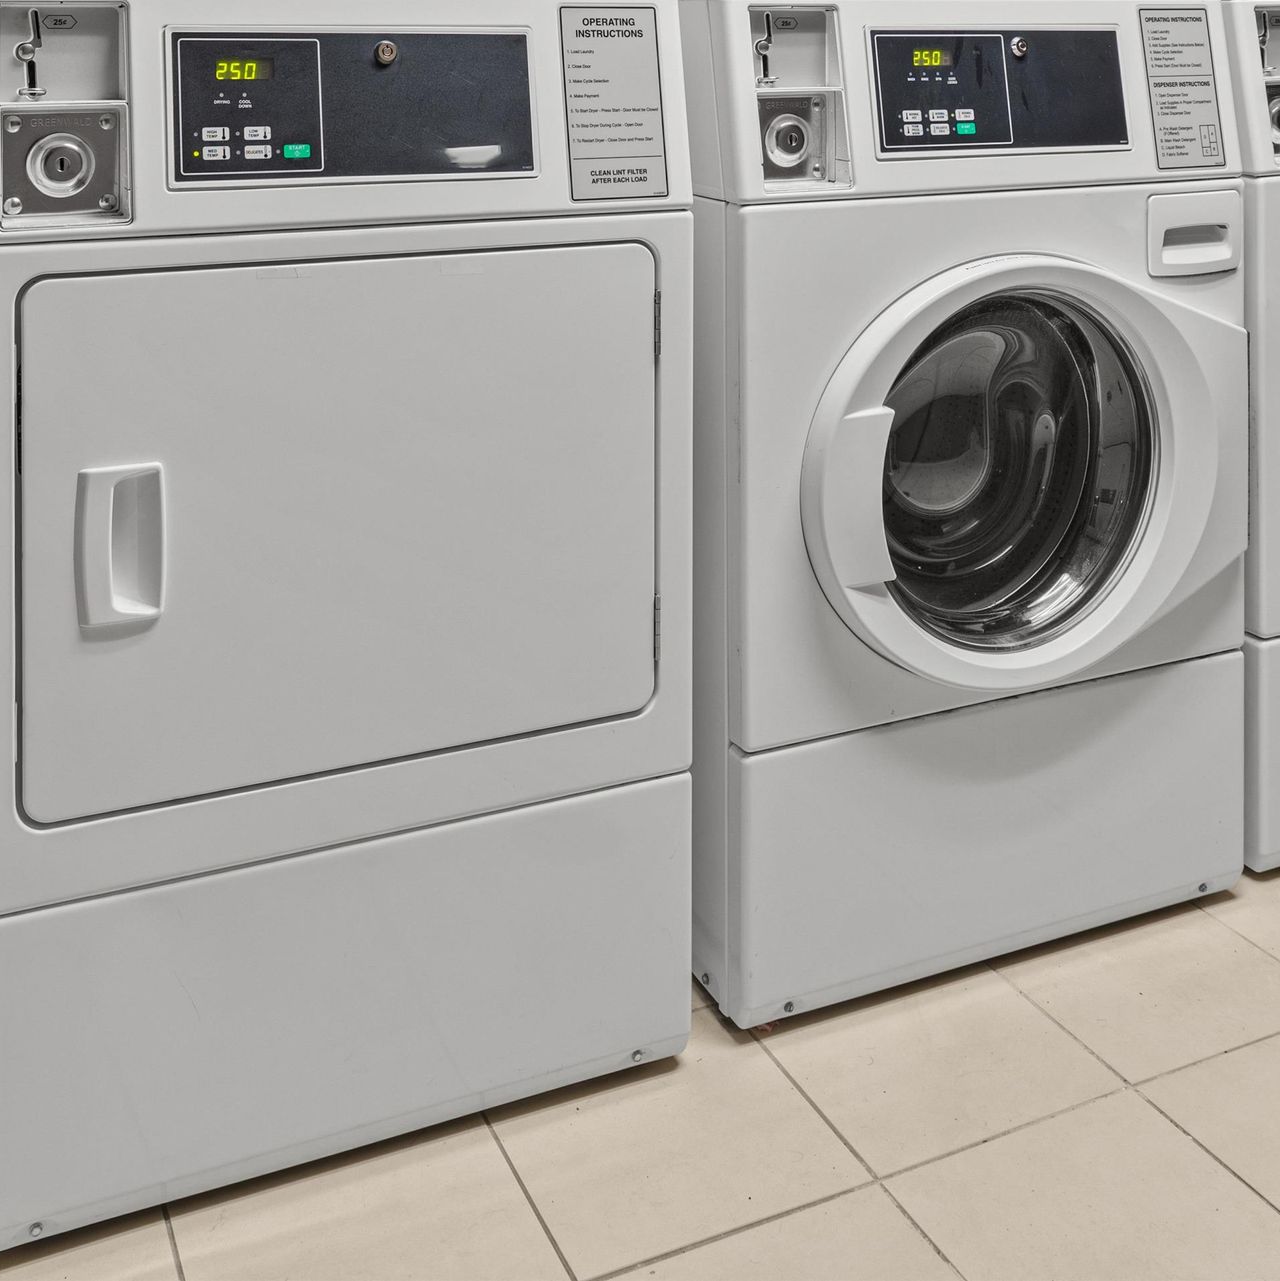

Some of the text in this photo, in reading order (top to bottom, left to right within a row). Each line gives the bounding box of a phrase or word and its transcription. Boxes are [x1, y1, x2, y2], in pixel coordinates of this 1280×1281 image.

[582, 18, 635, 26] OPERATING
[575, 30, 643, 38] INSTRUCTIONS
[914, 51, 940, 66] 250
[216, 63, 256, 80] 250
